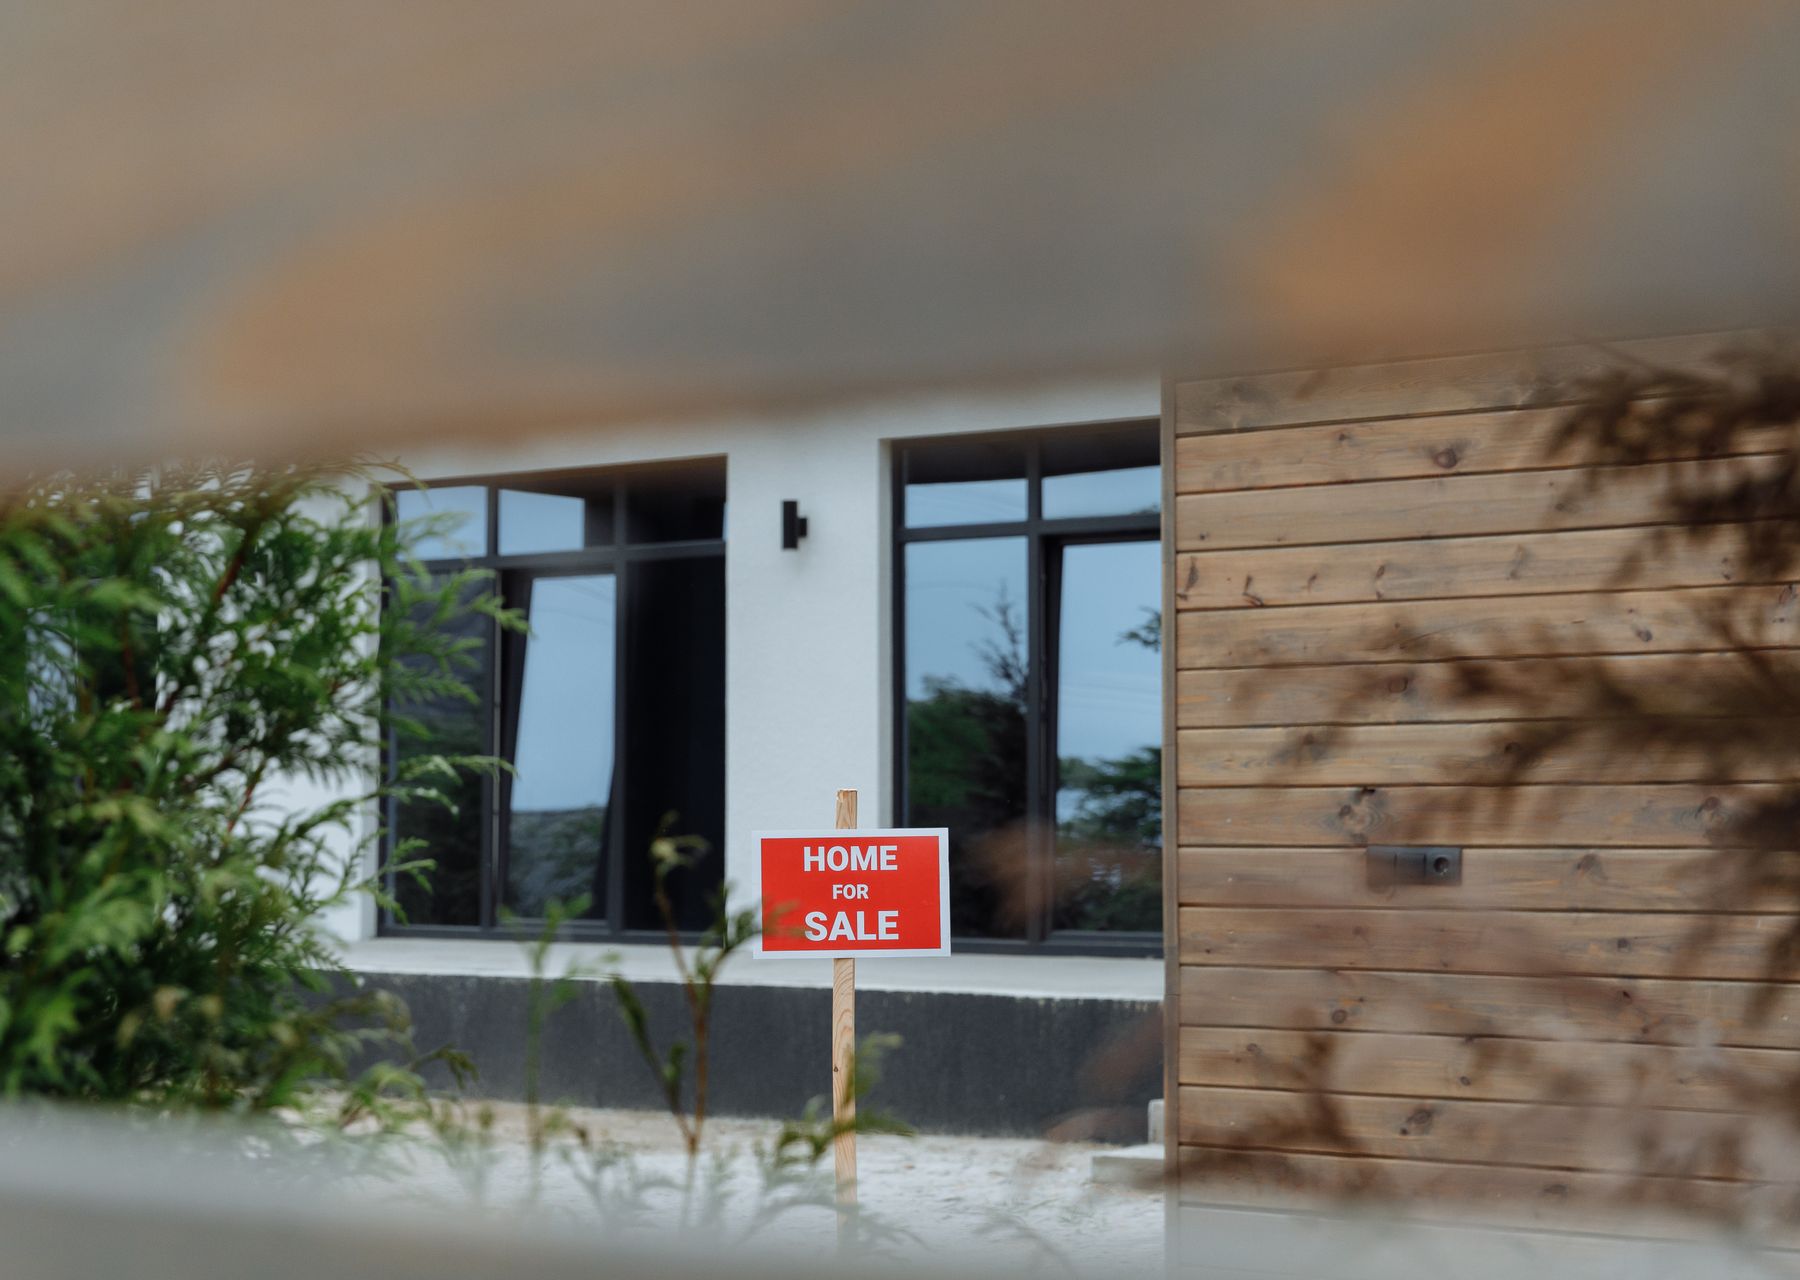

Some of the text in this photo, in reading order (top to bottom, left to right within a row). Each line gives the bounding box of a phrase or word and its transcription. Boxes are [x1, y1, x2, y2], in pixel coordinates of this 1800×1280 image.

[803, 845, 898, 872] HOME
[832, 883, 869, 900] FOR
[804, 910, 899, 942] SALE
